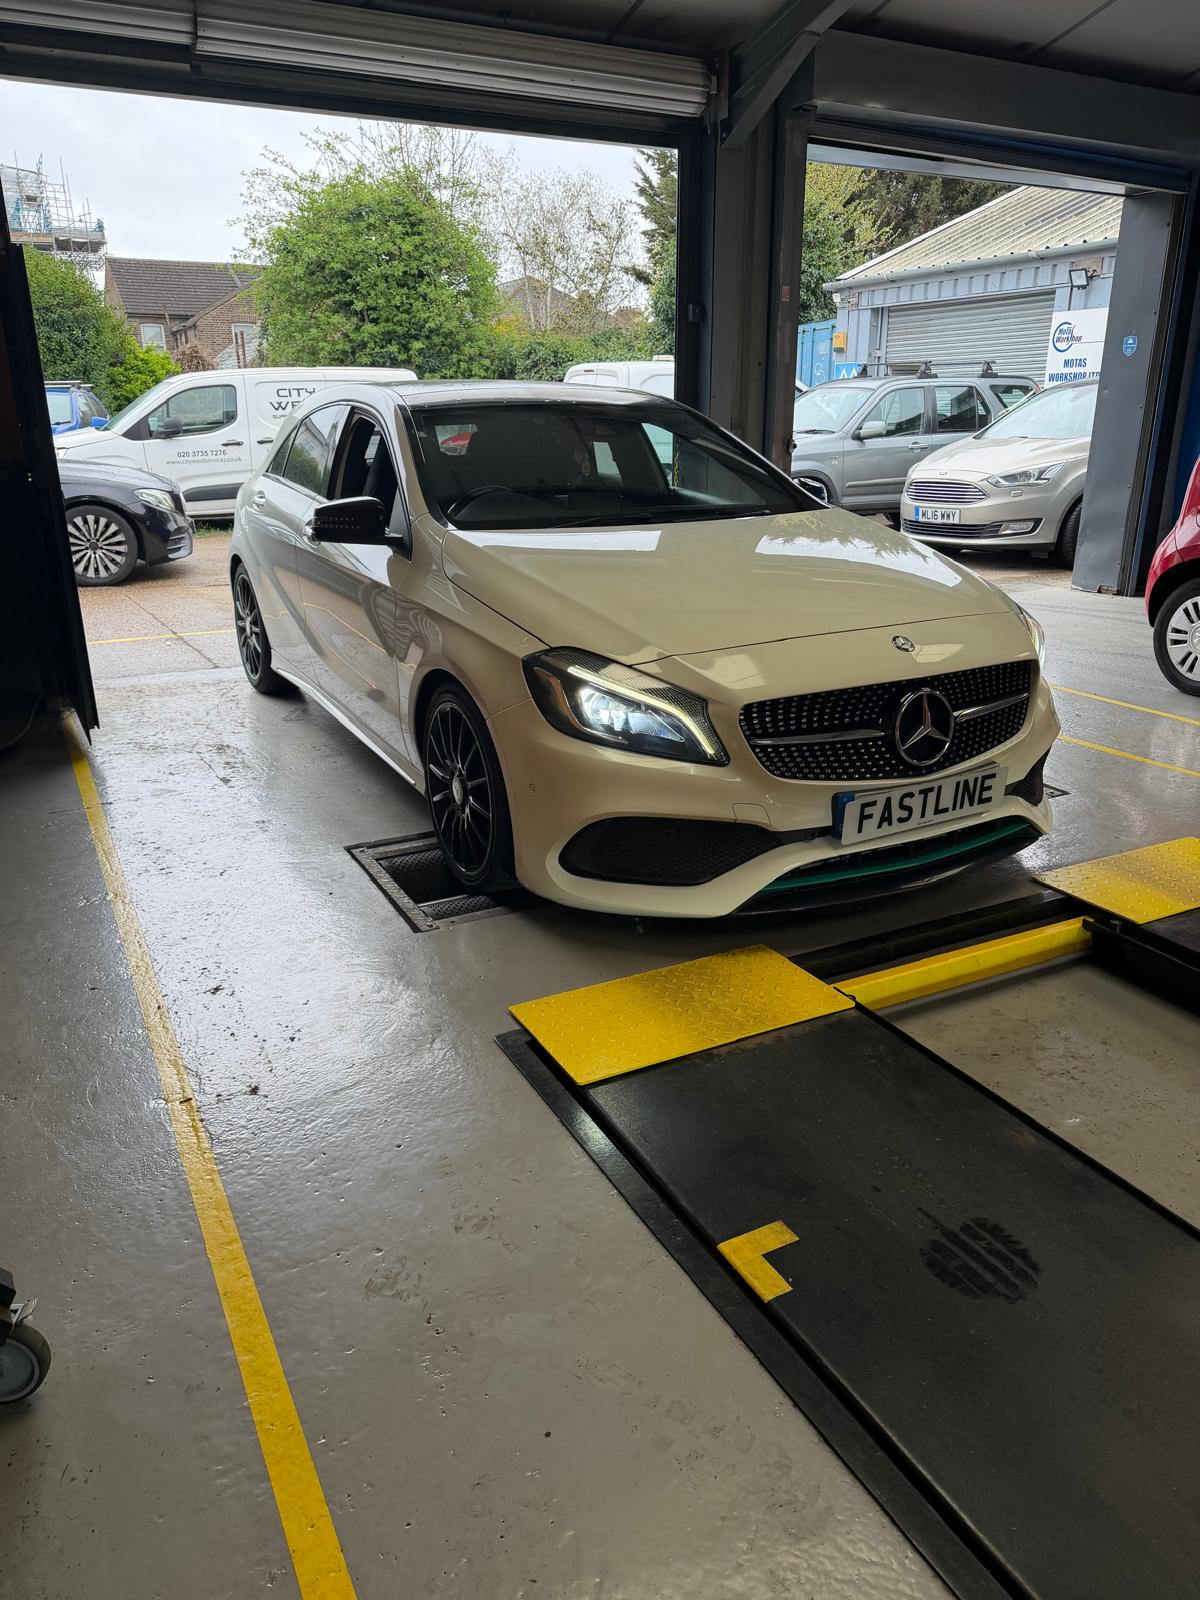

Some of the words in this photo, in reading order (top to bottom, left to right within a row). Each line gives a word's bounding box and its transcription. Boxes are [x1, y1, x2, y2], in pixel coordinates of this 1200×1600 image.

[1063, 358, 1087, 368] MOTAS
[1048, 371, 1087, 382] WORKSHOP
[276, 387, 316, 398] CITY
[210, 449, 227, 457] 7276
[921, 509, 939, 521] ML16
[940, 510, 957, 521] WWY
[857, 772, 997, 834] FASTLINE
